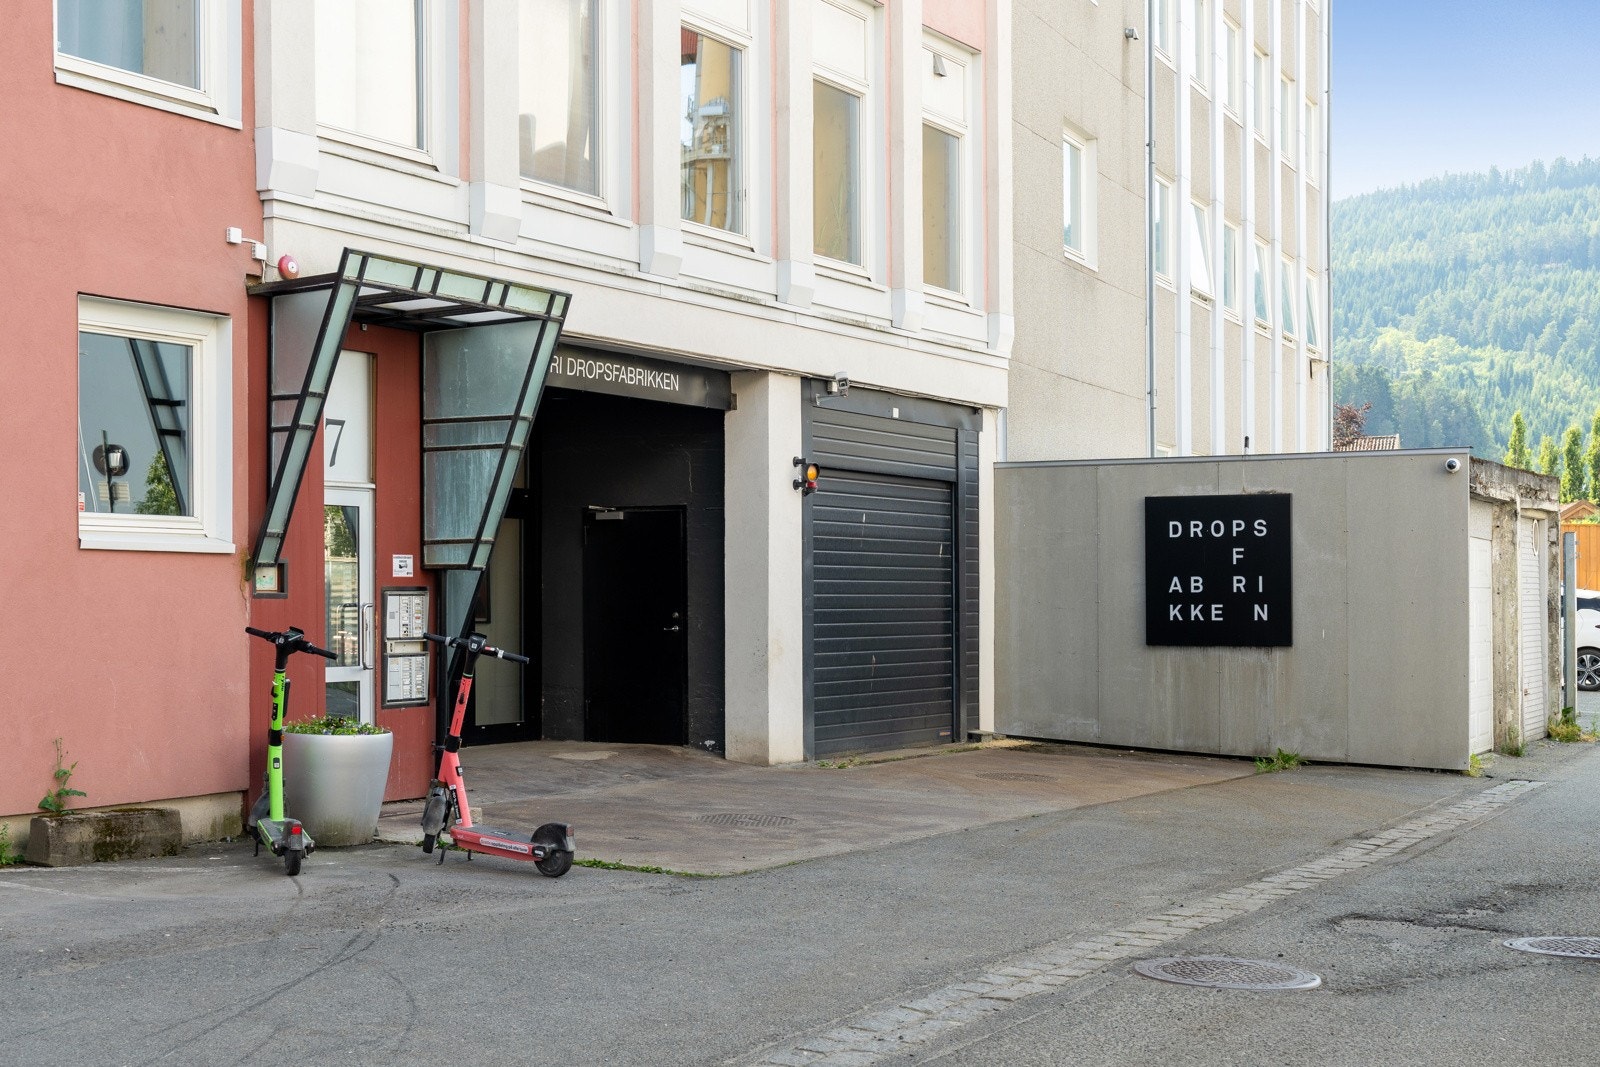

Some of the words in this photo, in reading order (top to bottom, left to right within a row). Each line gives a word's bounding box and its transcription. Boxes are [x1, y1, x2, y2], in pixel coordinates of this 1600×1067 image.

[566, 357, 679, 391] DROPSFABRIKKEN
[325, 417, 346, 467] 7
[1168, 519, 1268, 538] DROPS
[1232, 547, 1245, 565] F
